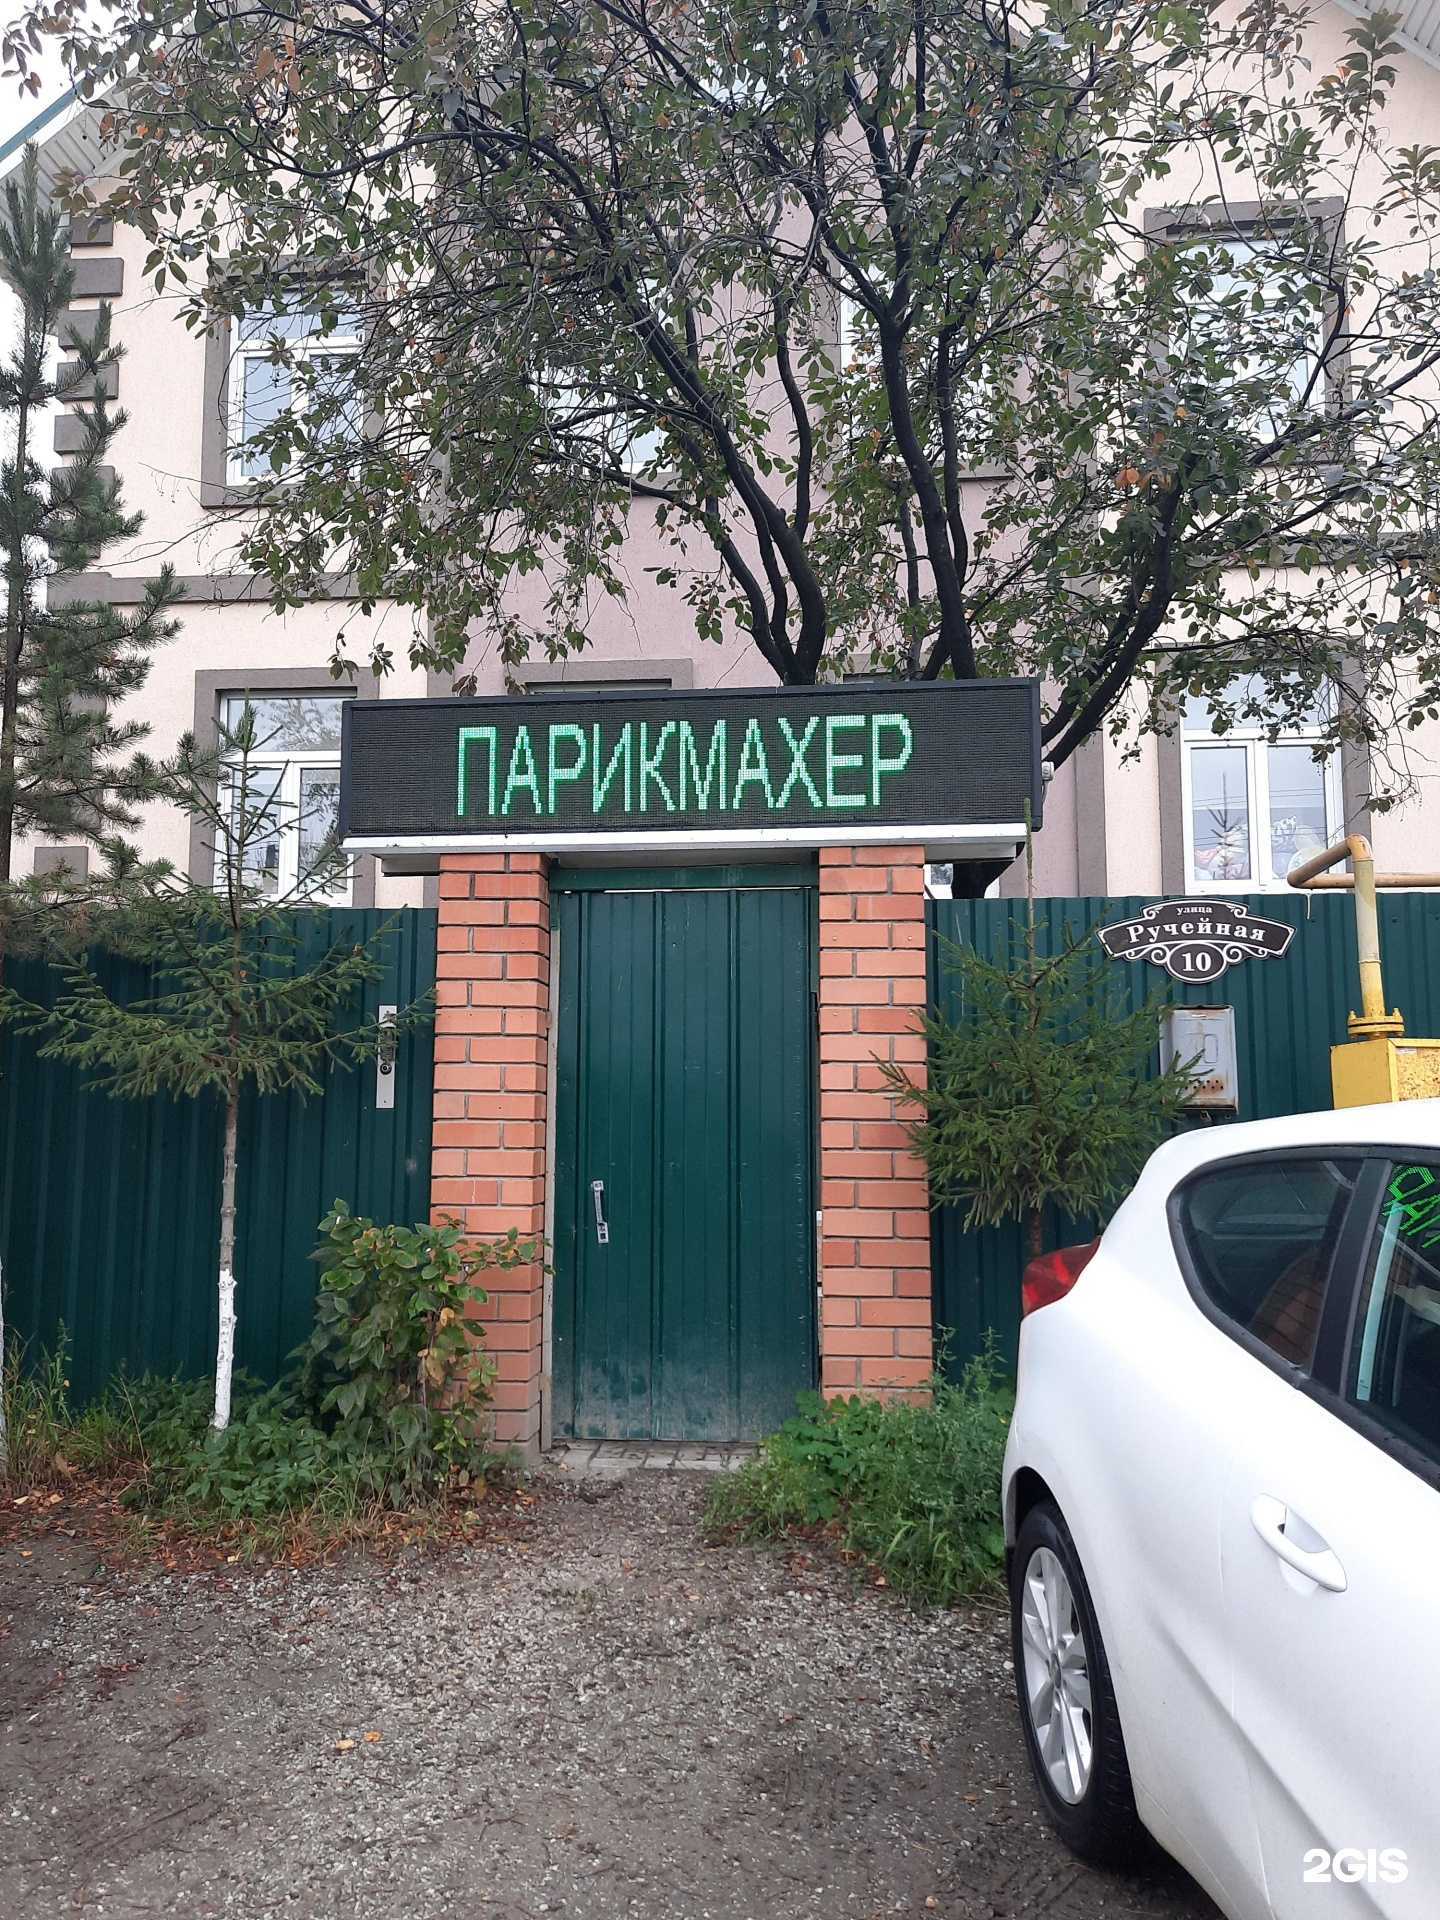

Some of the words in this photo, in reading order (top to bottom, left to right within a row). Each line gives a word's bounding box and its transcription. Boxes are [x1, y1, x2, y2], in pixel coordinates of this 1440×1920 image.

[457, 713, 912, 815] ПАРИКМАХЕР
[1176, 906, 1213, 916] улица
[1126, 917, 1266, 943] Ручейная
[1181, 952, 1212, 972] 10
